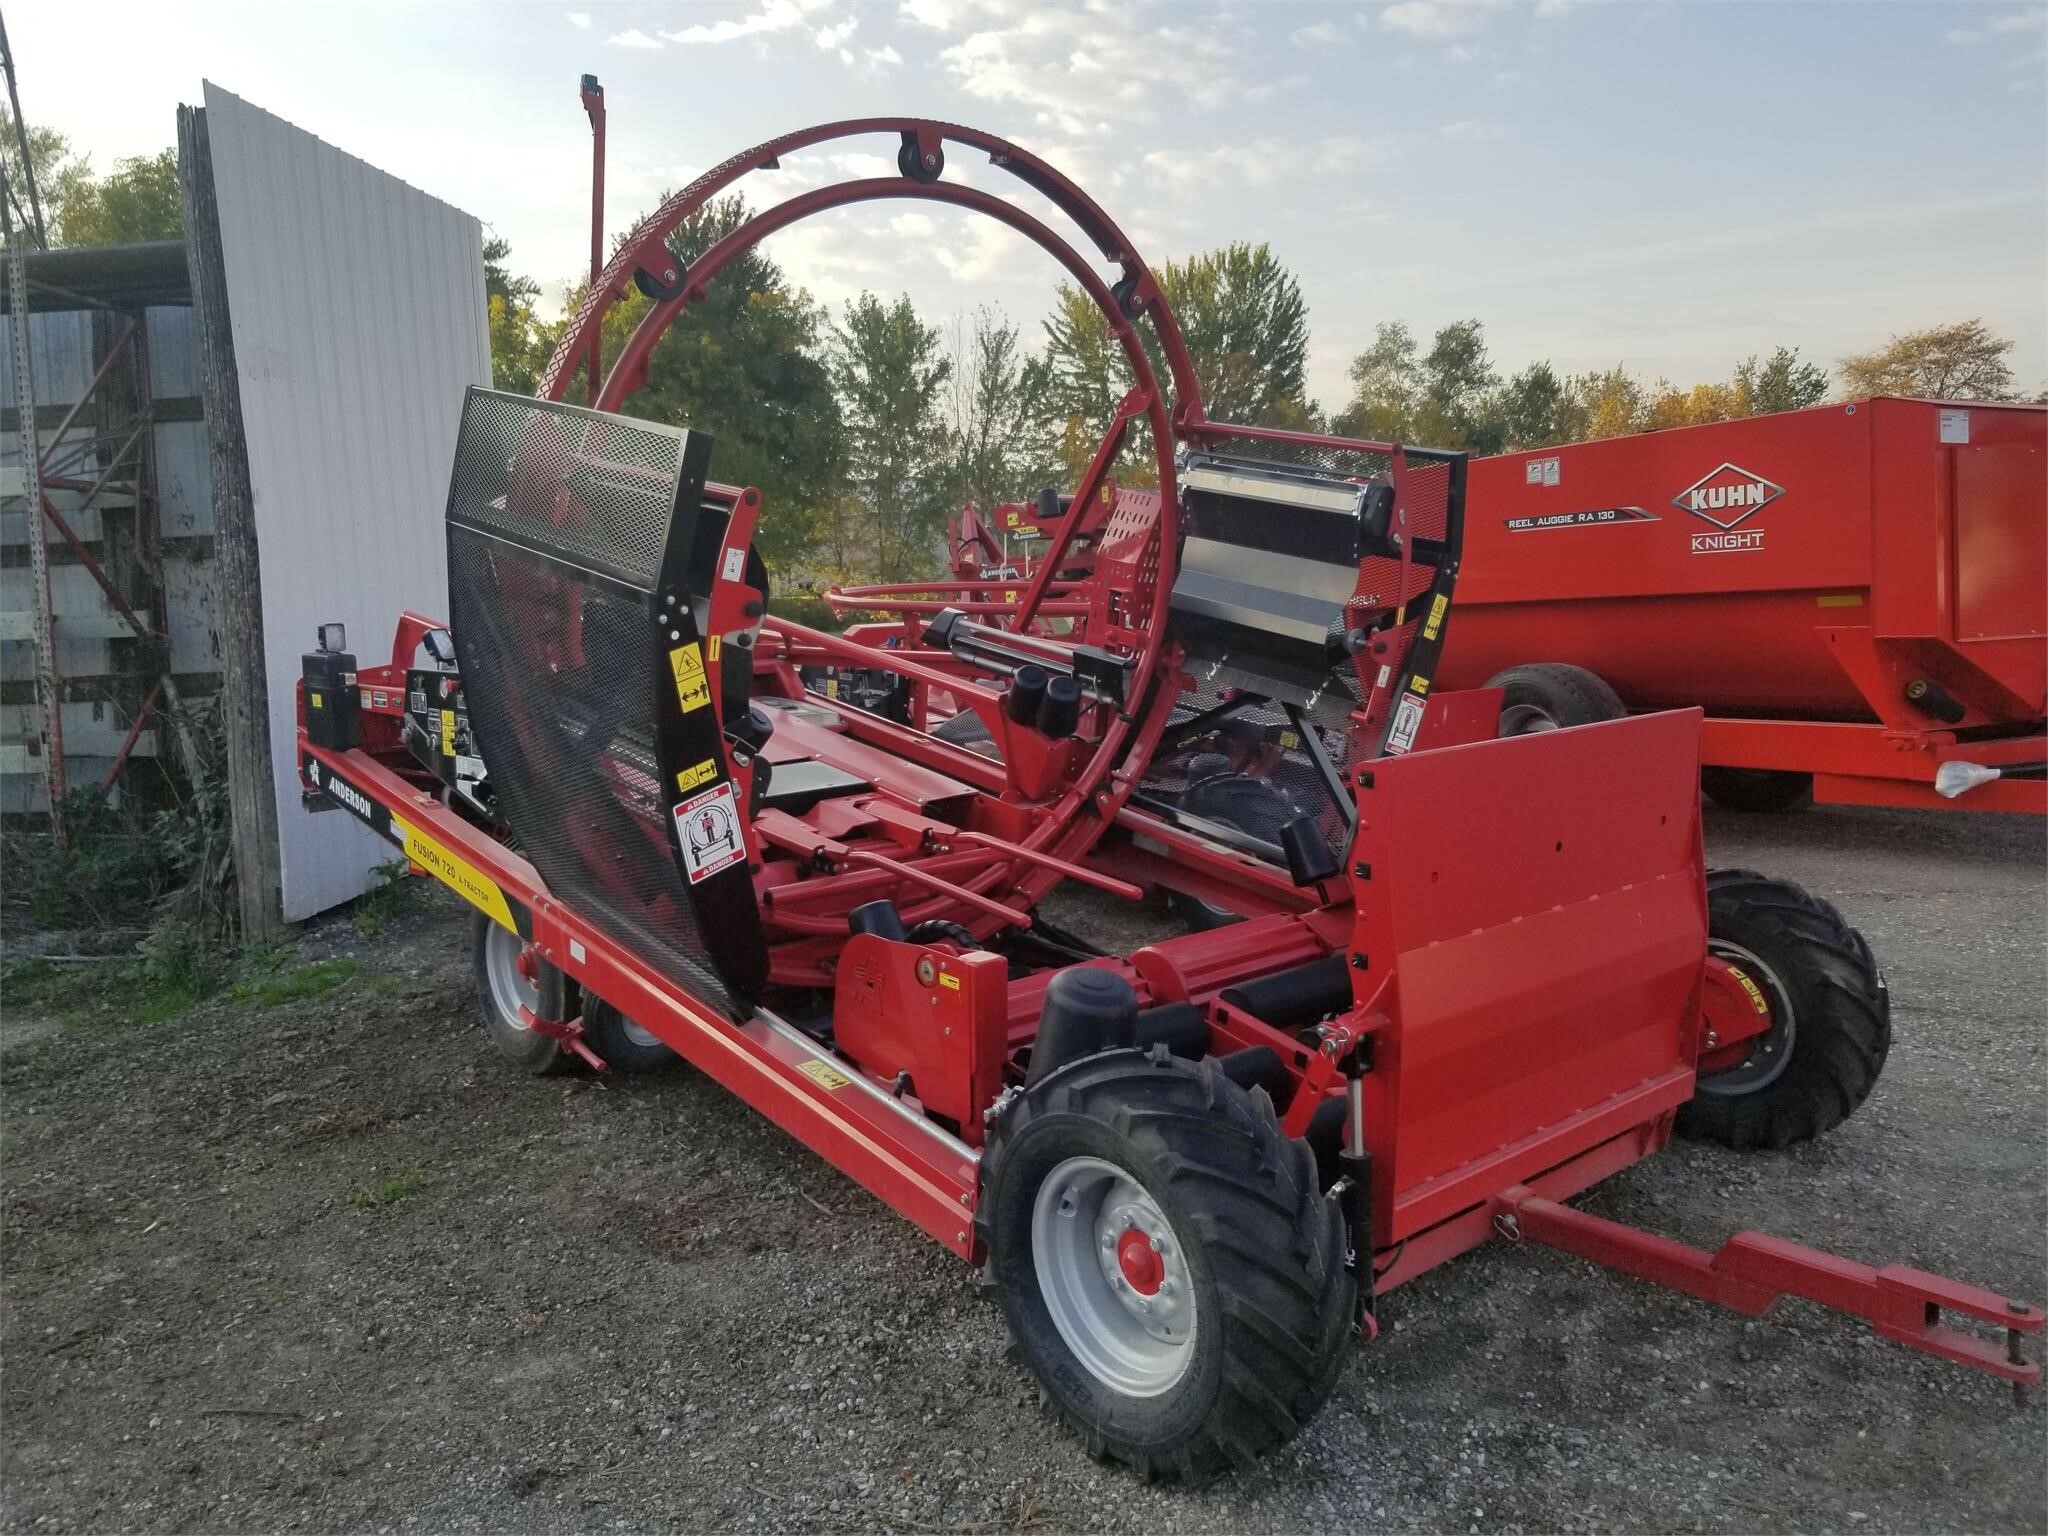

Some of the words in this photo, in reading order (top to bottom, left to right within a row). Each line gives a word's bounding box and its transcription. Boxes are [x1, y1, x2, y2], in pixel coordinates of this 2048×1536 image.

[1691, 482, 1764, 510] KUHN
[1509, 519, 1534, 529] REEL
[1537, 514, 1574, 526] AUGGIE
[1578, 513, 1594, 522] RA
[1598, 510, 1615, 520] 130
[1692, 533, 1765, 550] KNIGHT
[328, 776, 371, 819] ANDERSON
[692, 790, 720, 808] DANGER
[413, 839, 440, 867] FUSION
[441, 859, 456, 879] 720
[708, 854, 735, 873] DANGER
[1345, 1248, 1356, 1267] HC
